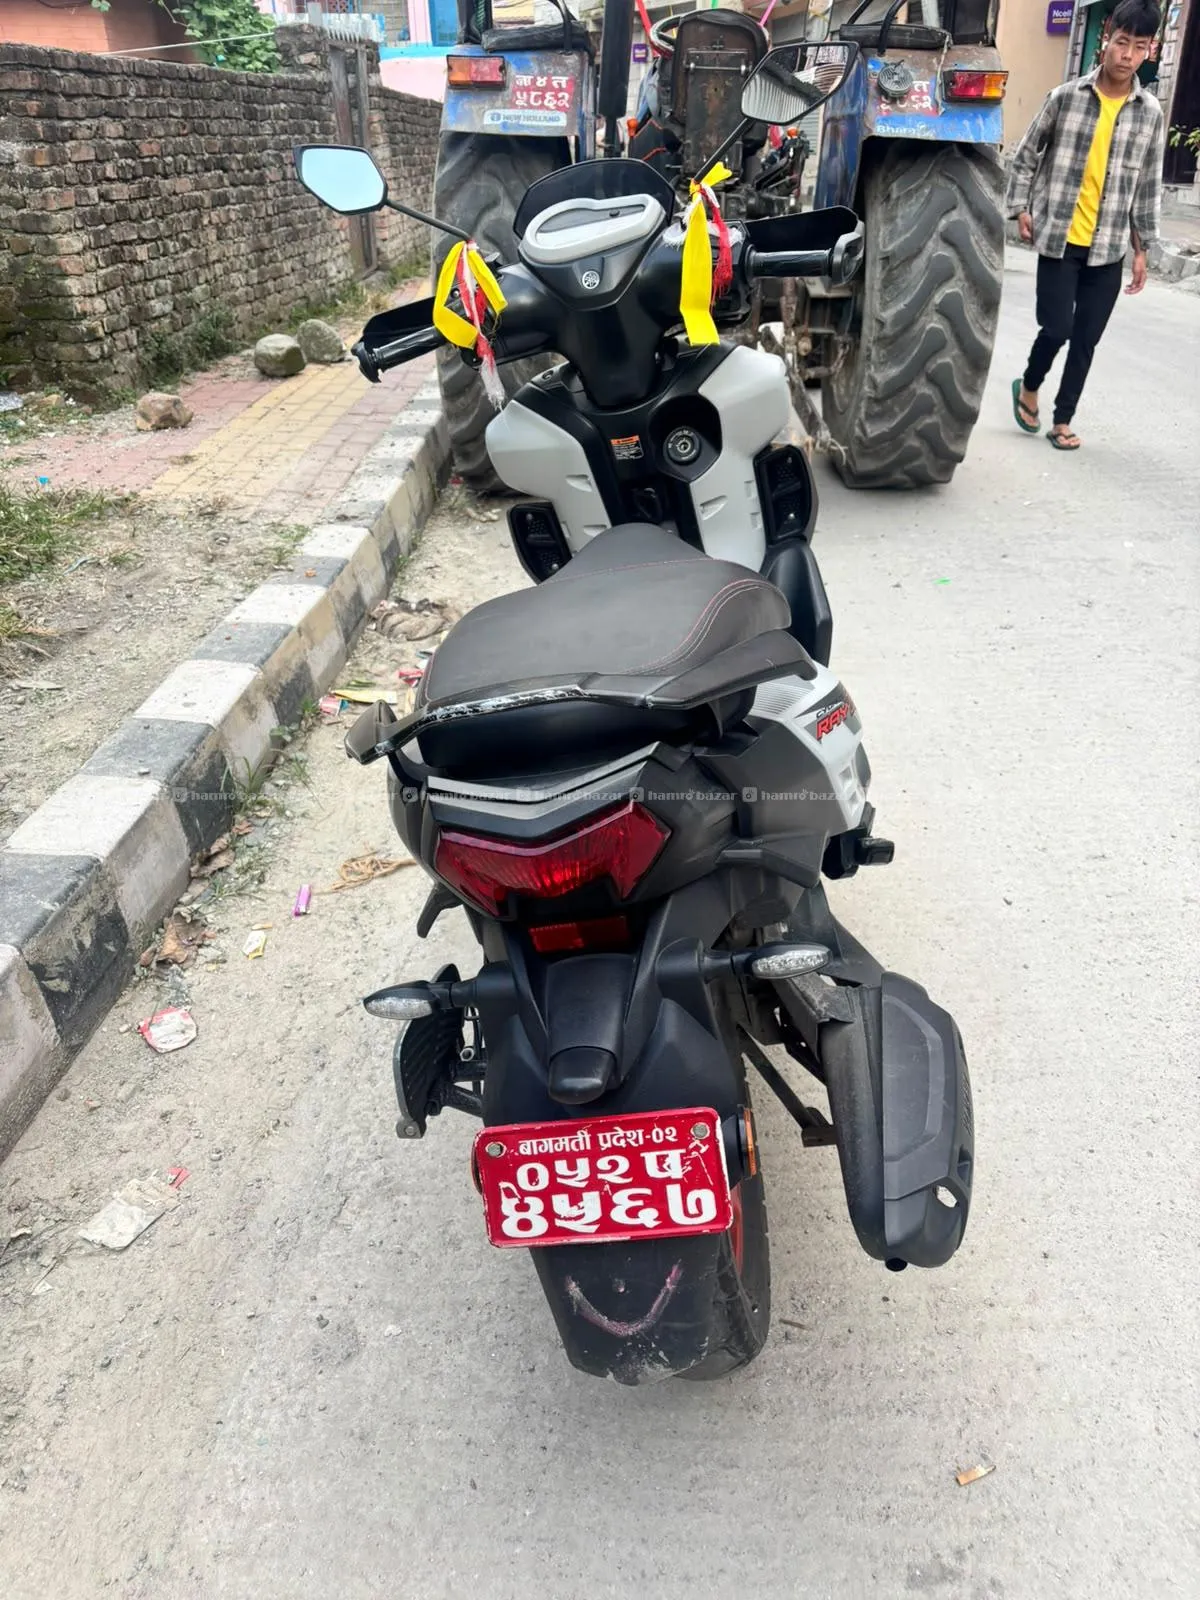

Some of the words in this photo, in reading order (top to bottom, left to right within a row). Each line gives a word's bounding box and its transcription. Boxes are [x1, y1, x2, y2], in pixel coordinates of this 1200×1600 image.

[1052, 9, 1072, 18] Ncell
[518, 1129, 591, 1156] बागमती
[516, 1155, 634, 1192] ०५२
[640, 1148, 687, 1180] प
[500, 1183, 717, 1239] ४५६७
